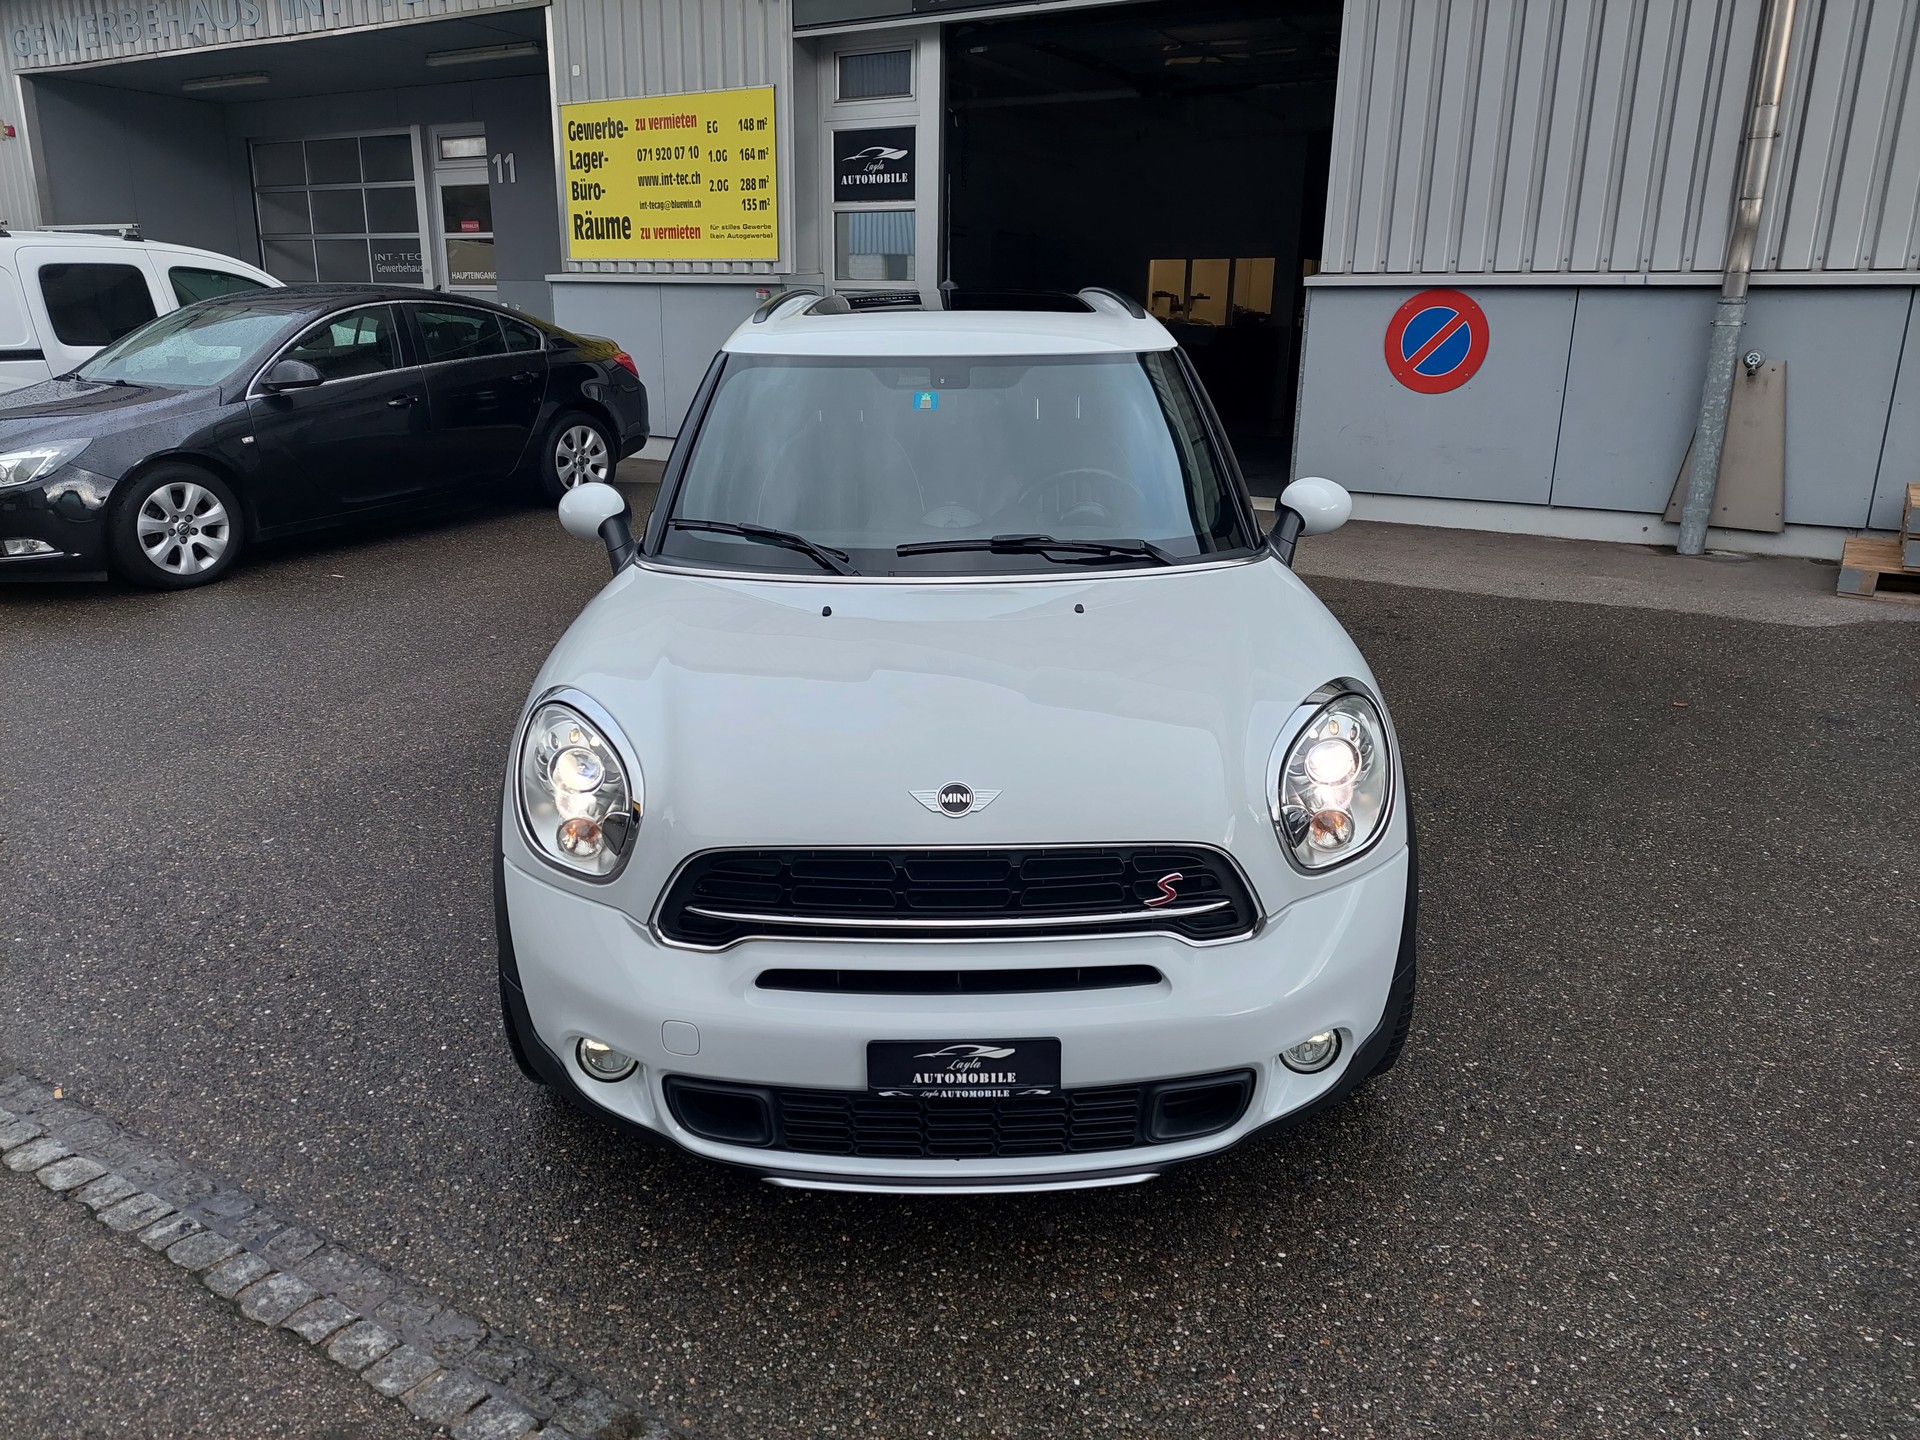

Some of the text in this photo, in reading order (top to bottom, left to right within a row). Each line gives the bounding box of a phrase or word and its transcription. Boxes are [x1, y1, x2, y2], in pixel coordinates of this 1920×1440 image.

[12, 0, 261, 57] GEWERBEHAUS
[568, 117, 628, 141] Gewerbe-
[635, 113, 697, 131] zu vermieten
[706, 121, 718, 133] EG
[738, 118, 754, 132] 148
[569, 150, 609, 173] Lager-
[637, 145, 699, 162] 071 920 07 10
[739, 148, 755, 161] 164
[492, 153, 516, 183] 11
[638, 171, 701, 187] www.int-tec.ch
[740, 178, 756, 191] 288
[841, 173, 908, 185] AUTOMOBILE
[571, 178, 606, 201] Büro-
[639, 199, 702, 210] int-tecag@bluewin.ch
[741, 198, 757, 211] 135
[573, 211, 632, 241] Räume
[640, 224, 701, 240] zu vermieten
[376, 262, 423, 273] Gewerbehaus
[451, 271, 497, 280] HAUPTEINGANG
[941, 793, 971, 804] MINI
[1143, 872, 1183, 907] S
[947, 1057, 981, 1073] Layla
[912, 1072, 1016, 1084] AUTOMOBILE
[940, 1089, 1010, 1098] AUTOMOBILE
